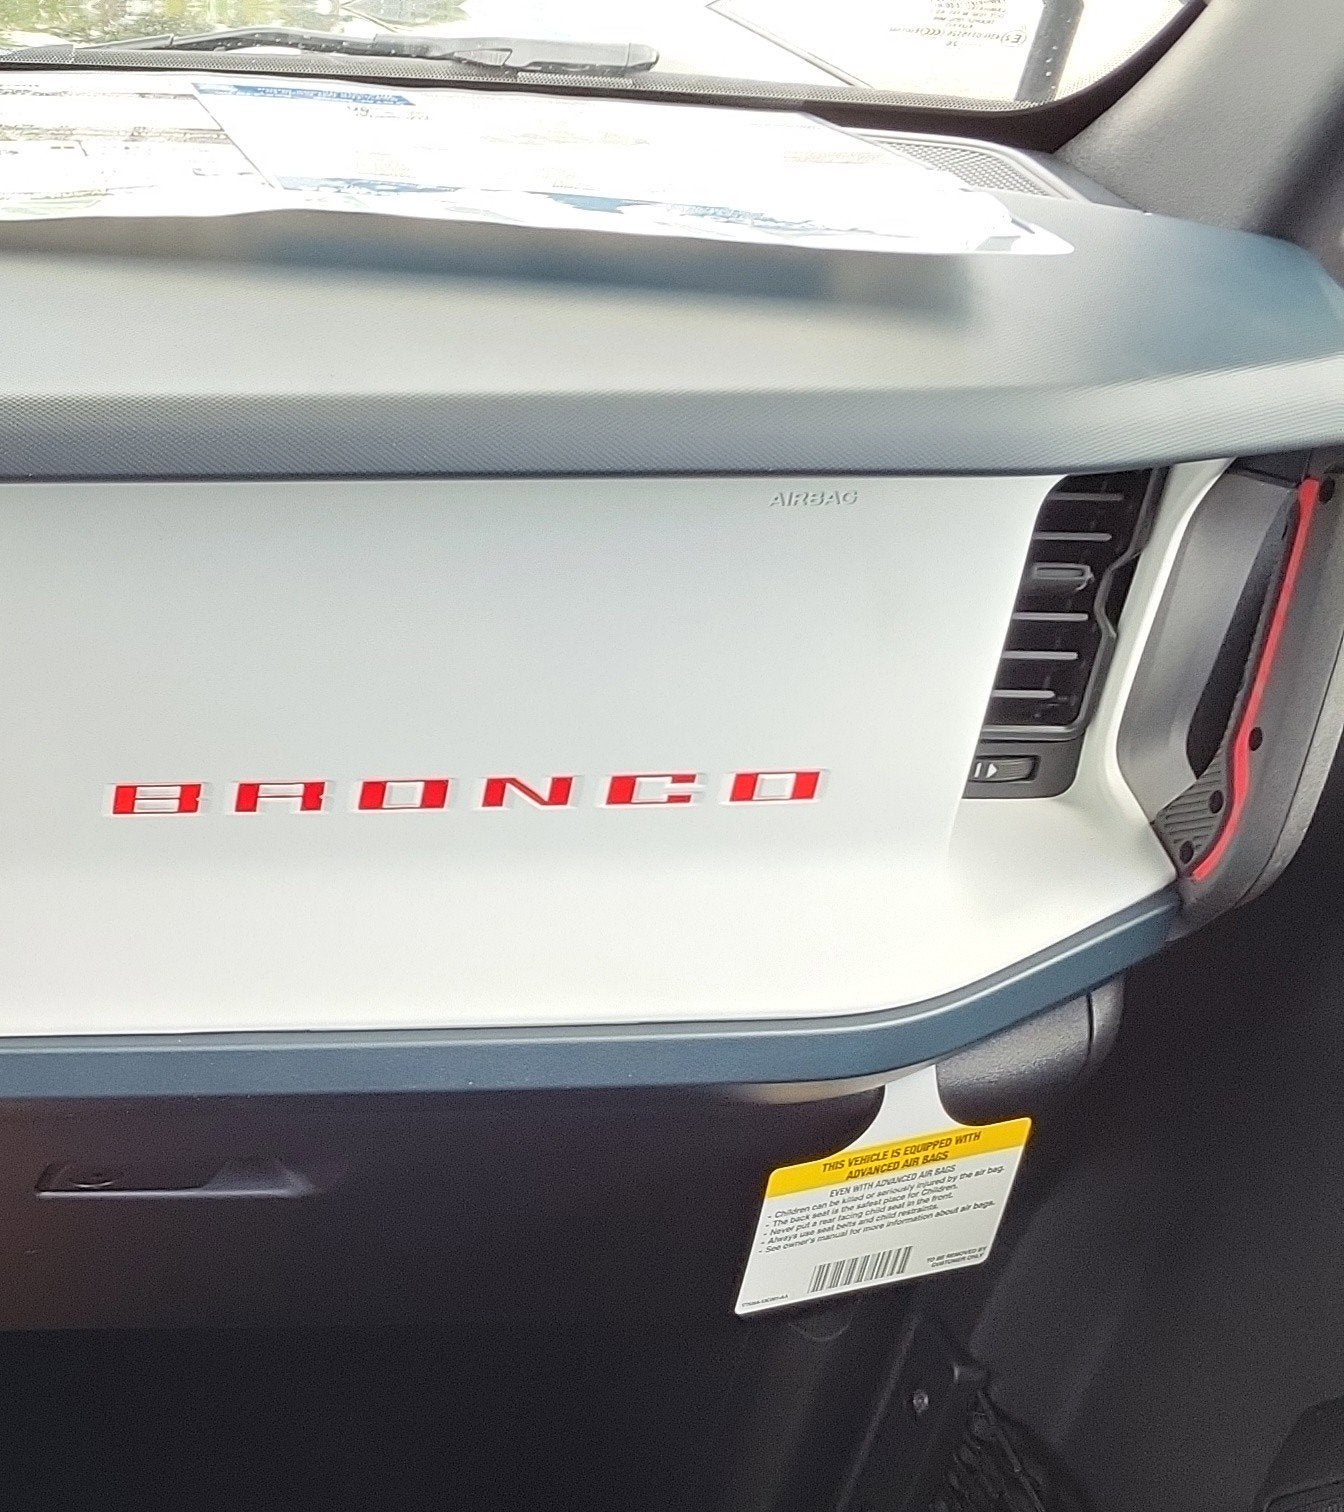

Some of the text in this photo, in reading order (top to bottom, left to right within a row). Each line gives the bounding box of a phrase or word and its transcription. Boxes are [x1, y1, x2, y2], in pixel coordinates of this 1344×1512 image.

[767, 491, 858, 507] AIRBAG
[110, 770, 824, 815] BRONCO
[821, 1130, 981, 1173] THIS VEHICLE IS EQUIPPED WITH
[845, 1150, 949, 1180] ADVANCED AIR BAGS
[774, 1167, 986, 1218] Children can killed seriously injured the air
[829, 1164, 956, 1197] EVEN WITH ADVANCED AIR BAGS
[769, 1195, 930, 1235] Never put rear facing child seat the
[772, 1192, 905, 1227] The back seat the safest place
